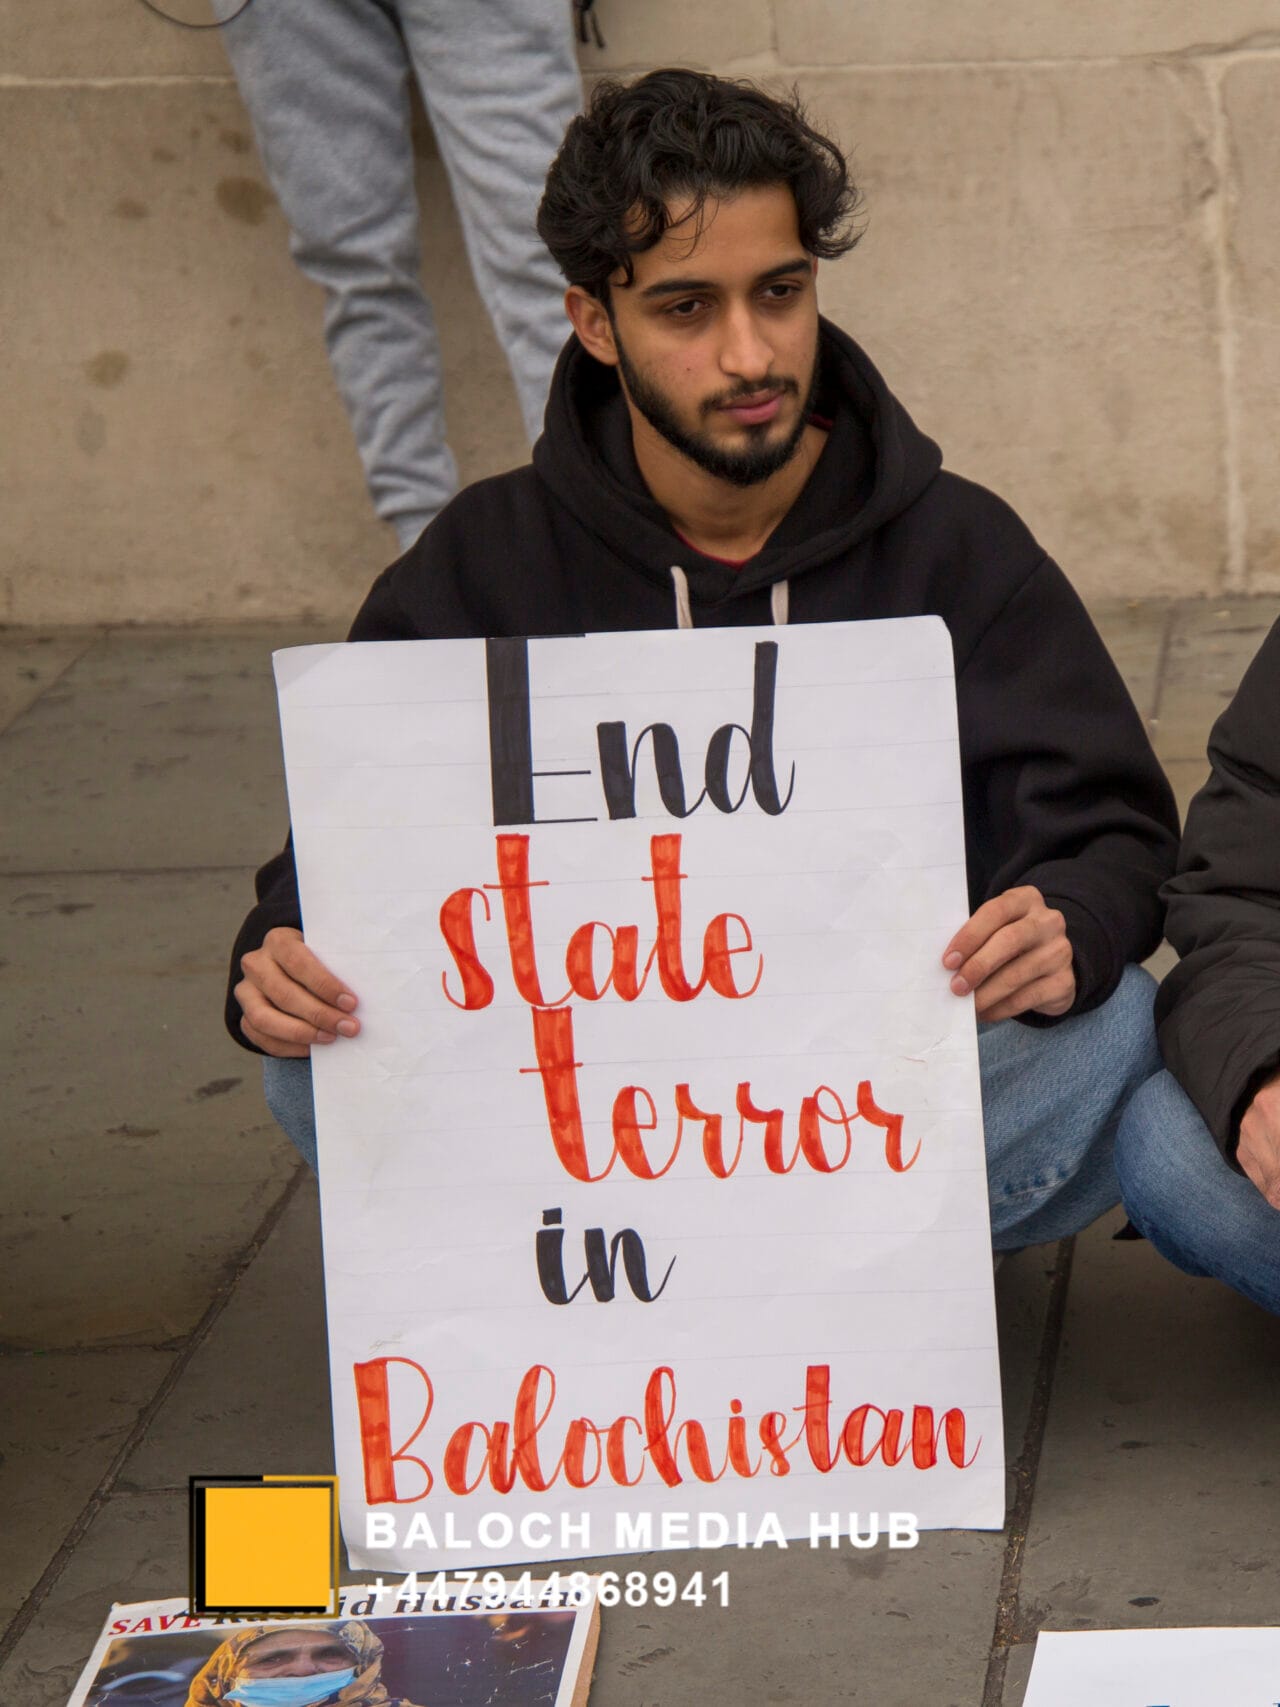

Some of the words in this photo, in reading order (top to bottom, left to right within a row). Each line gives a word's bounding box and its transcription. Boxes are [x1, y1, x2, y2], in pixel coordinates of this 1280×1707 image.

[486, 634, 795, 827] End
[440, 833, 764, 1011] state
[519, 1006, 922, 1183] terror
[536, 1208, 677, 1305] in
[353, 1356, 985, 1506] Balochistan
[107, 1613, 201, 1637] SAVE
